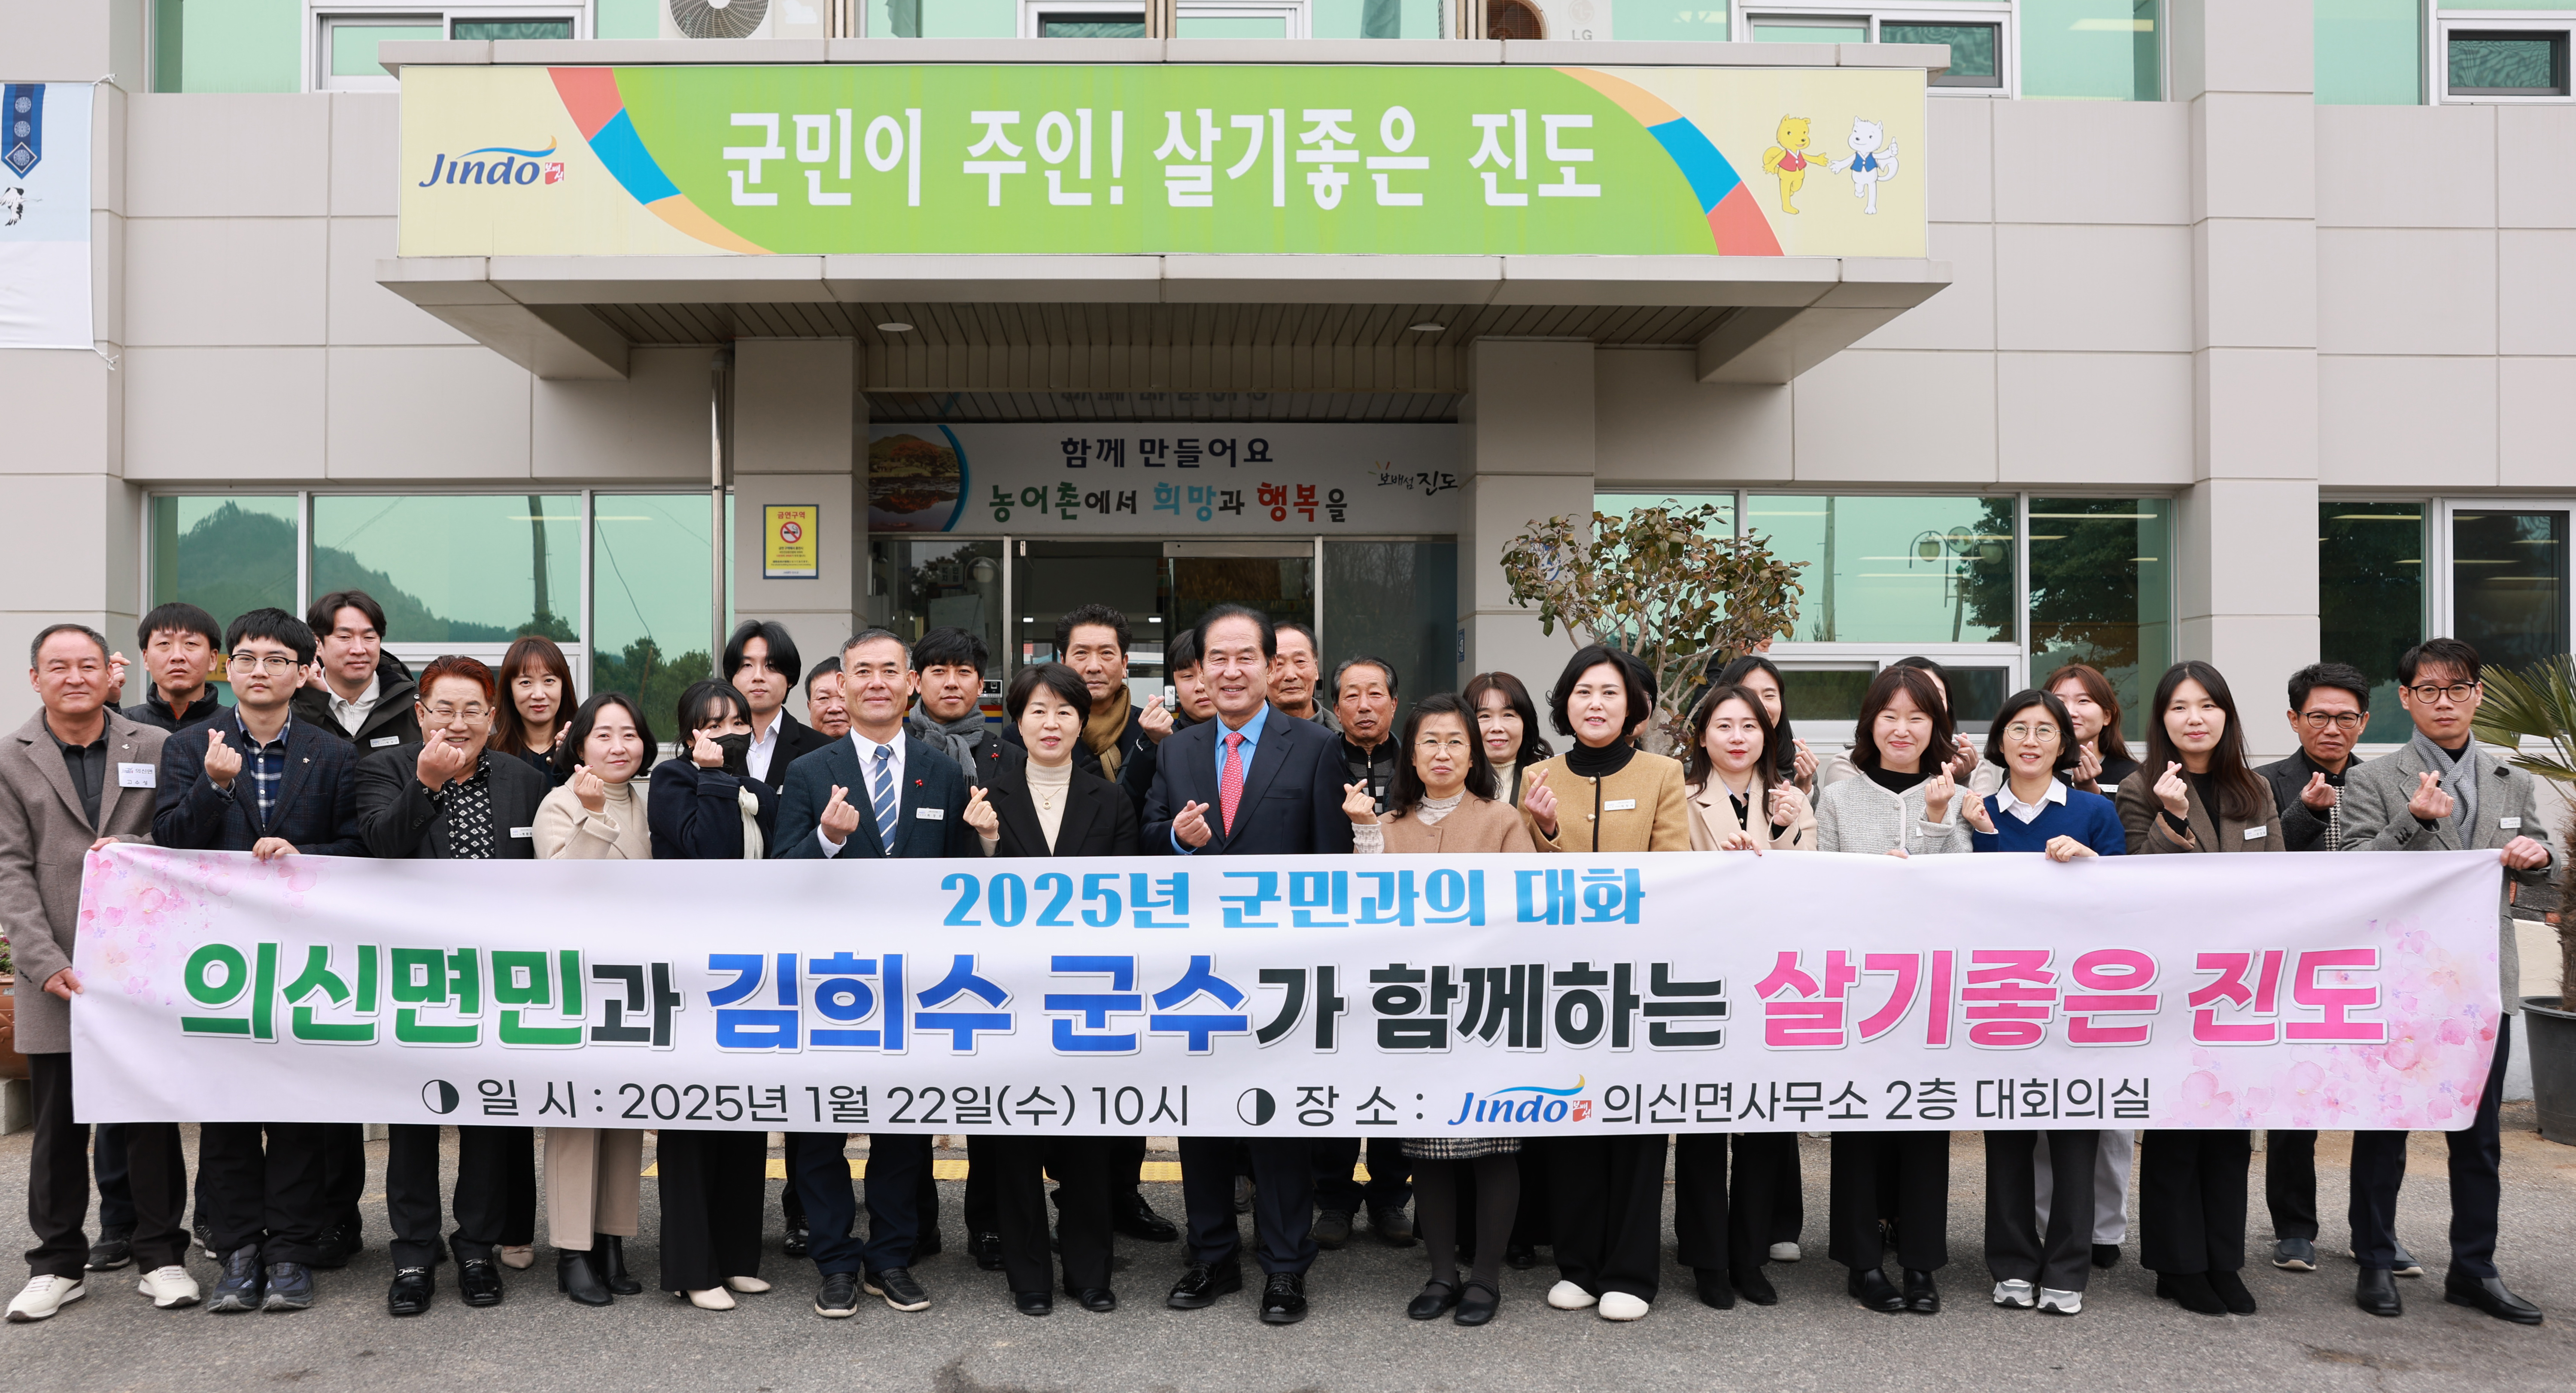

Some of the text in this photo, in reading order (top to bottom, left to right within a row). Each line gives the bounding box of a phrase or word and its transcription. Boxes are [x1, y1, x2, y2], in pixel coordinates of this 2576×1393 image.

[1573, 30, 1592, 40] LG
[419, 154, 540, 187] Jindo
[723, 106, 1601, 210] 군민이 주인! 살기좋은 진도
[1061, 438, 1273, 468] 함께 만들어요
[989, 481, 1347, 523] 농어촌에서 희망과 행복을
[1378, 471, 1458, 496] 보배섬 진도
[942, 869, 1646, 928] 2025년 군민과의 대화
[182, 943, 2383, 1051] 의신면민과 김희수 군수가 함께하는 살기좋은 진도
[619, 1083, 787, 1122] 2025년
[806, 1086, 869, 1123] 1월
[888, 1086, 1075, 1125] 22일(수)
[1093, 1086, 1187, 1125] 10시
[1447, 1092, 1568, 1125] Jindo
[1603, 1081, 1868, 1124] 의신면사무소
[1886, 1078, 1956, 1119] 2층
[1977, 1078, 2149, 1119] 대회의실
